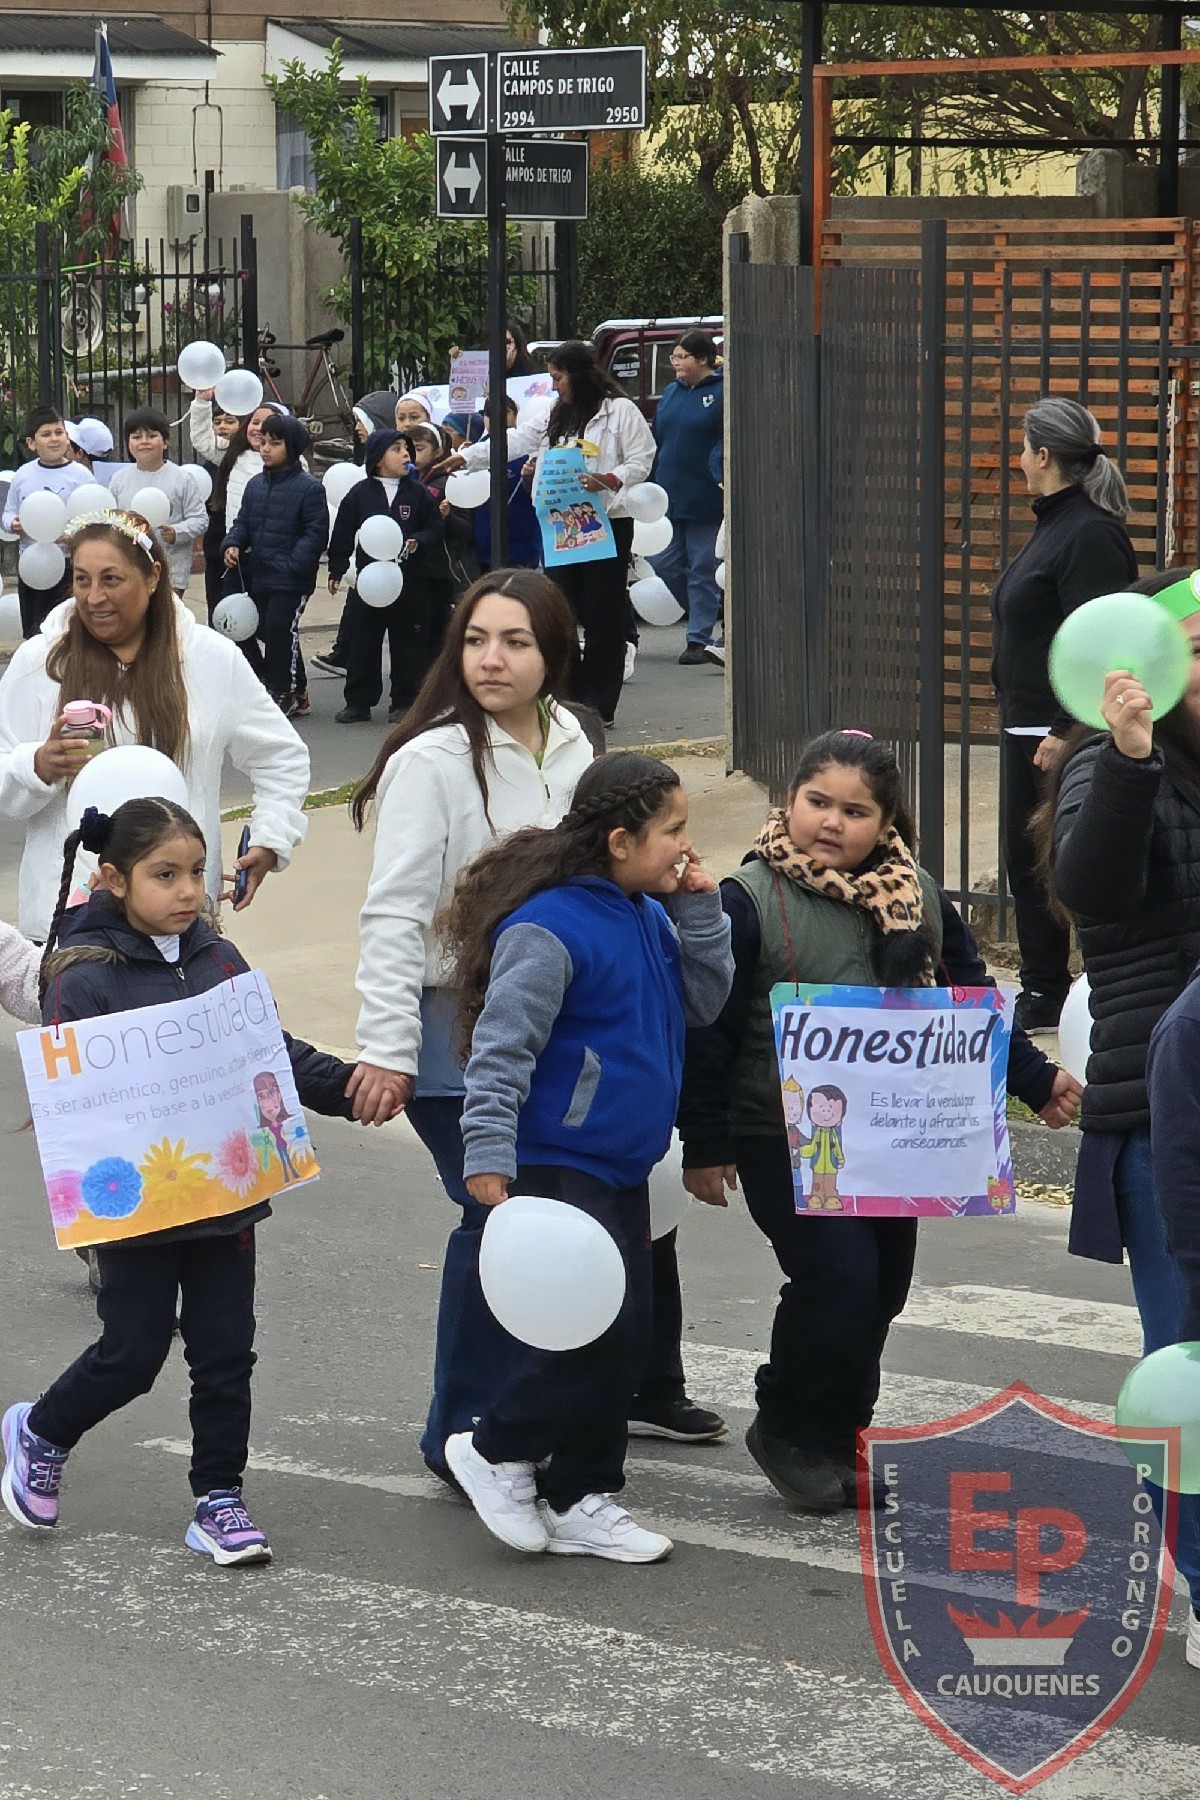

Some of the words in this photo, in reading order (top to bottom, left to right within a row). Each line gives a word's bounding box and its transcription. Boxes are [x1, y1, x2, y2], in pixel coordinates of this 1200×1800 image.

[503, 60, 540, 77] CALLE
[503, 78, 554, 96] CAMPOS
[558, 78, 573, 95] DE
[576, 77, 615, 94] TRIGO
[503, 110, 536, 127] 2994
[606, 106, 639, 123] 2950
[505, 147, 525, 163] ALLE
[505, 166, 534, 183] AMPOS
[537, 167, 547, 183] DE
[549, 168, 572, 184] TRIGO
[39, 974, 268, 1080] Honestidad
[780, 1011, 1002, 1069] Honestidad
[32, 1102, 51, 1119] Es
[53, 1099, 79, 1115] ser
[82, 1080, 165, 1111] auténtico,
[169, 1065, 227, 1095] genuino,
[870, 1091, 889, 1108] Es
[891, 1092, 924, 1108] llevar
[926, 1092, 936, 1108] la
[125, 1111, 147, 1126] en
[151, 1101, 188, 1121] base
[191, 1099, 200, 1110] a
[203, 1092, 216, 1107] la
[870, 1112, 917, 1128] delante
[919, 1117, 927, 1135] y
